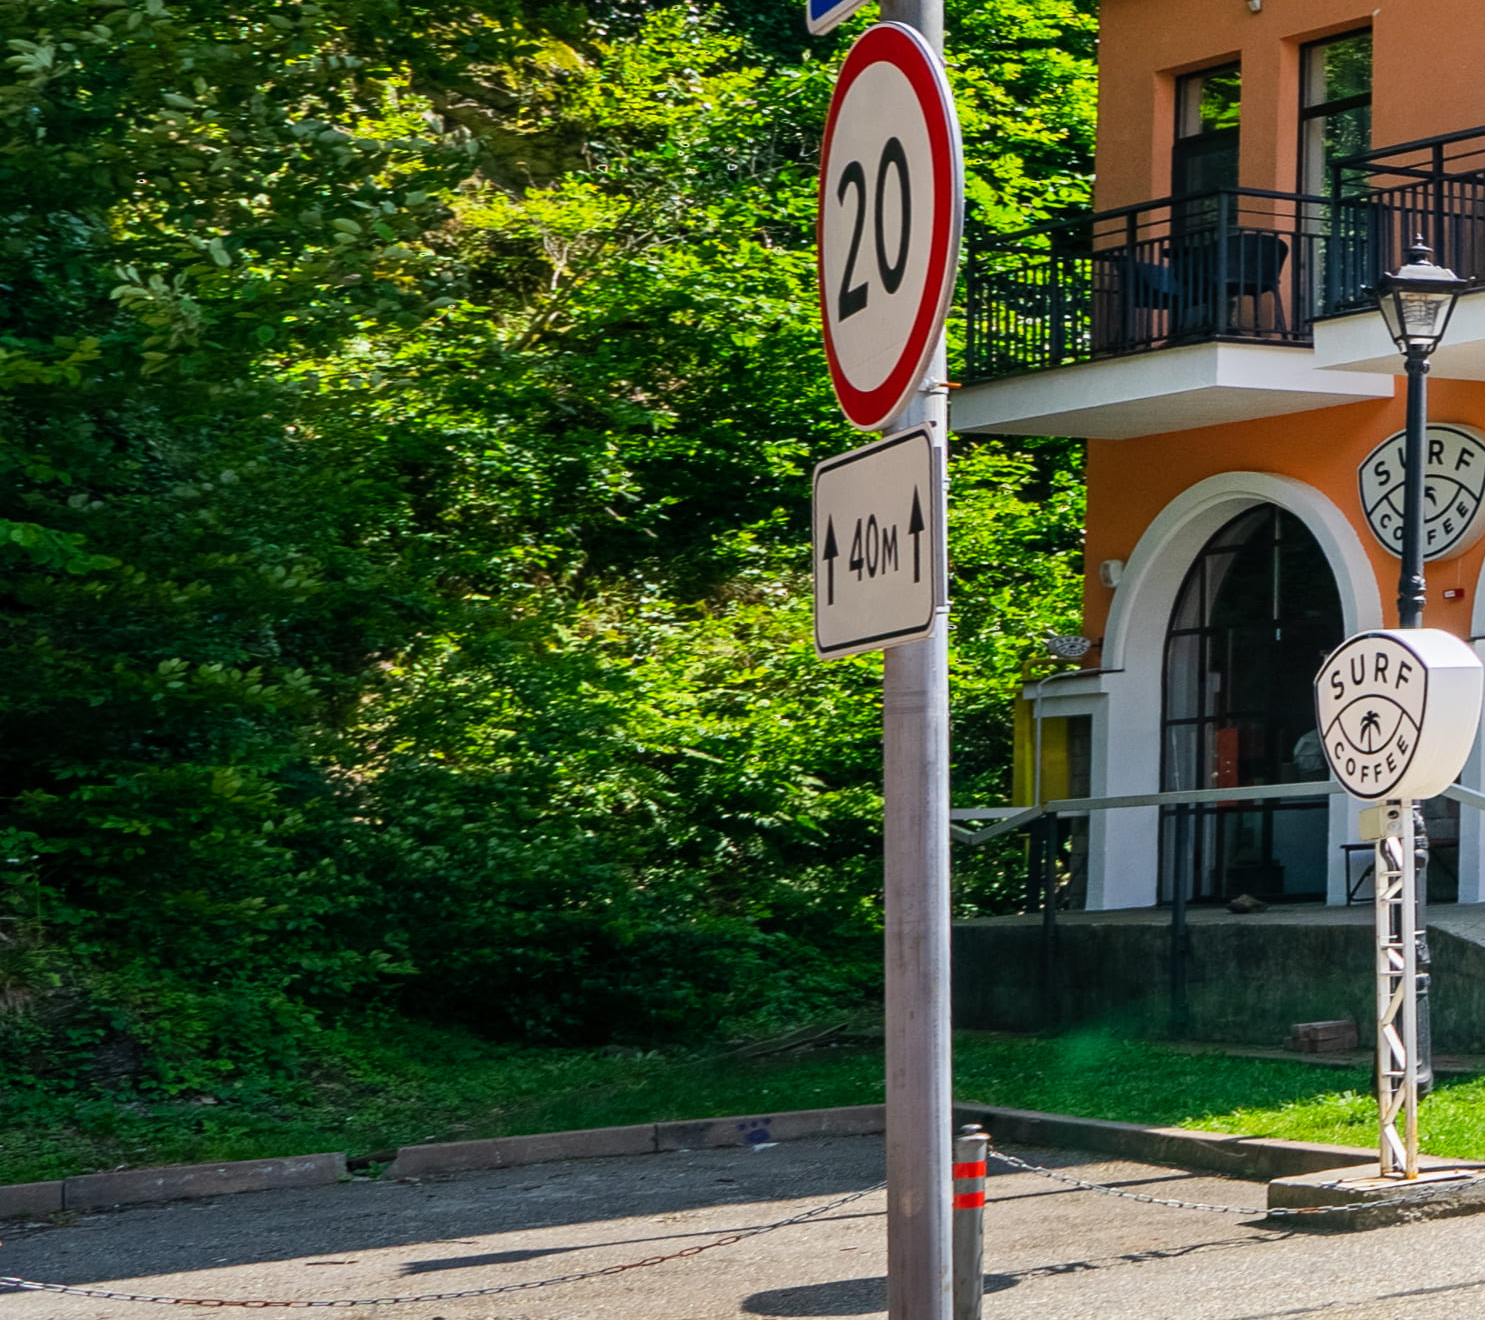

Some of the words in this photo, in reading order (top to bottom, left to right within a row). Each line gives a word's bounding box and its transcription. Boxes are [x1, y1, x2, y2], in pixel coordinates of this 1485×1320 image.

[836, 136, 912, 323] 20
[1380, 501, 1469, 546] COFEE
[1331, 652, 1412, 701] SURF
[1334, 734, 1409, 784] COFFEE
